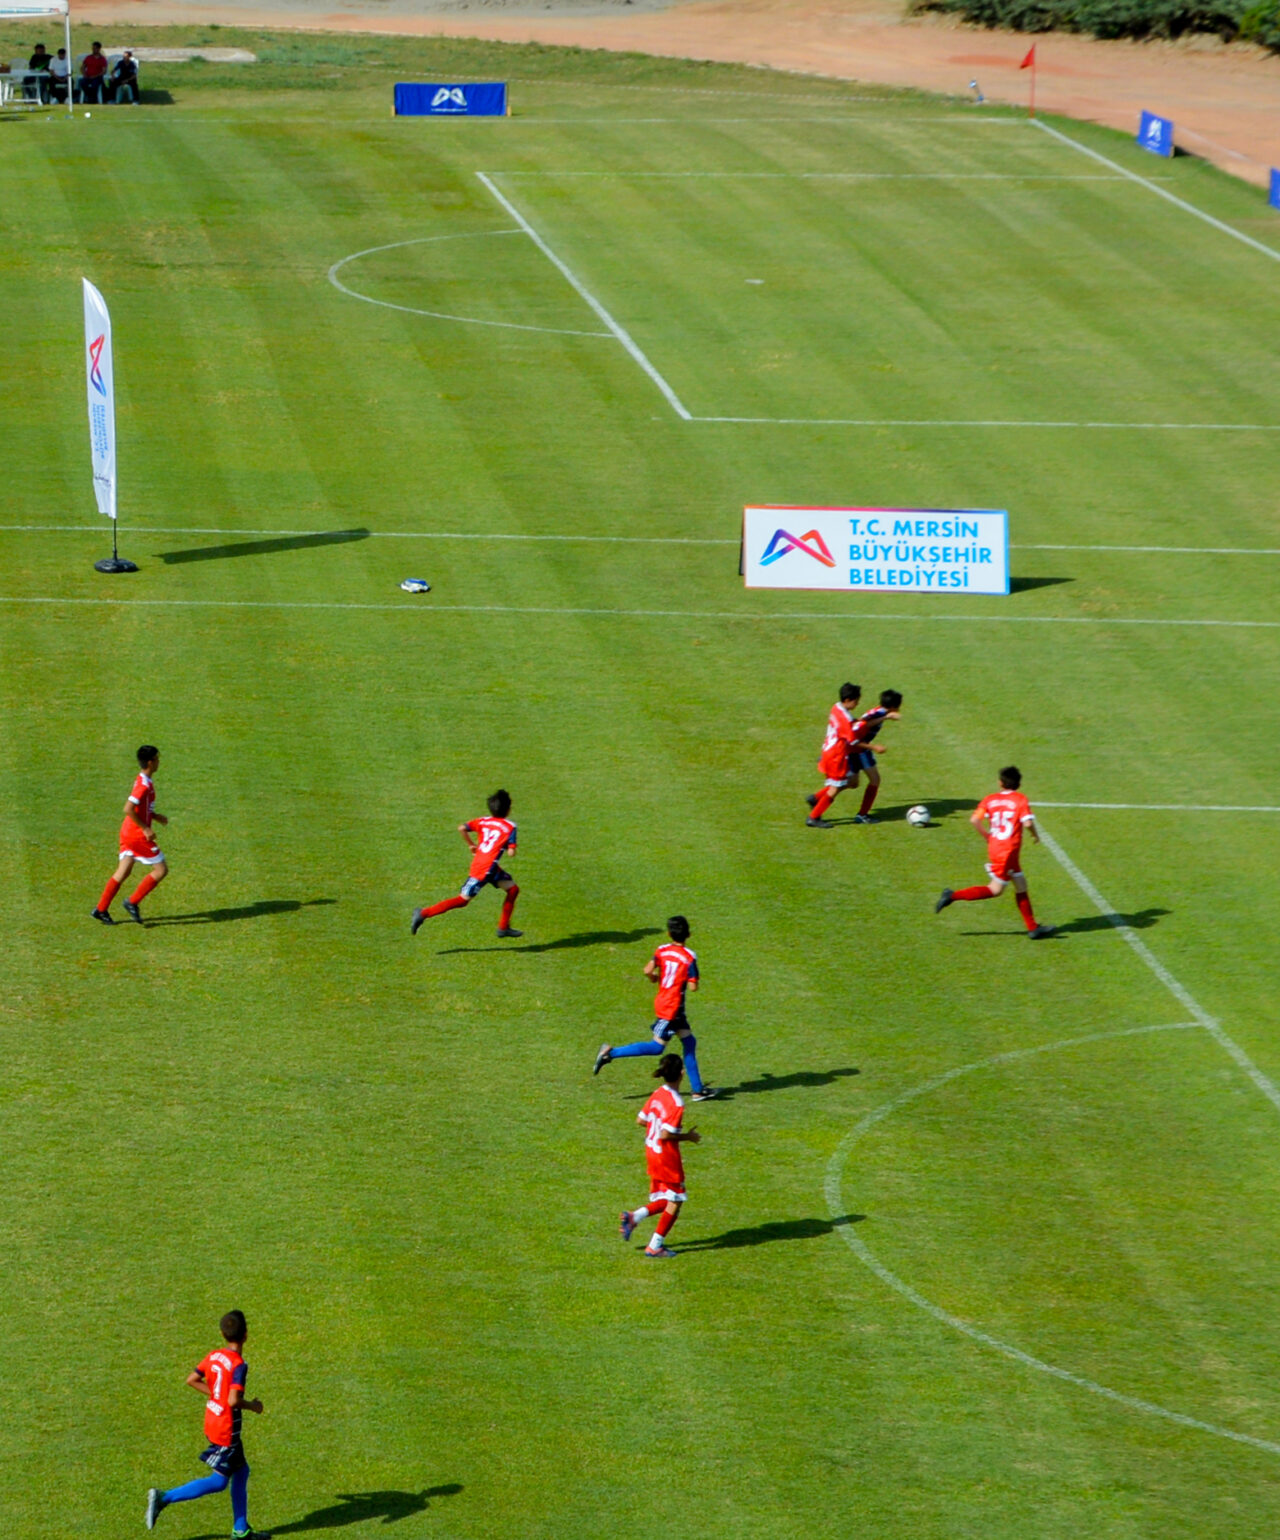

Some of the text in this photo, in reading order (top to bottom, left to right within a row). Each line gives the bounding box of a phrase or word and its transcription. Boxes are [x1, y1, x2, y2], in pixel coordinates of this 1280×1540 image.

[849, 516, 979, 539] T.C. MERSİN
[849, 539, 993, 566] BÜYÜKŞEHİR
[849, 564, 969, 588] BELEDİYESİ
